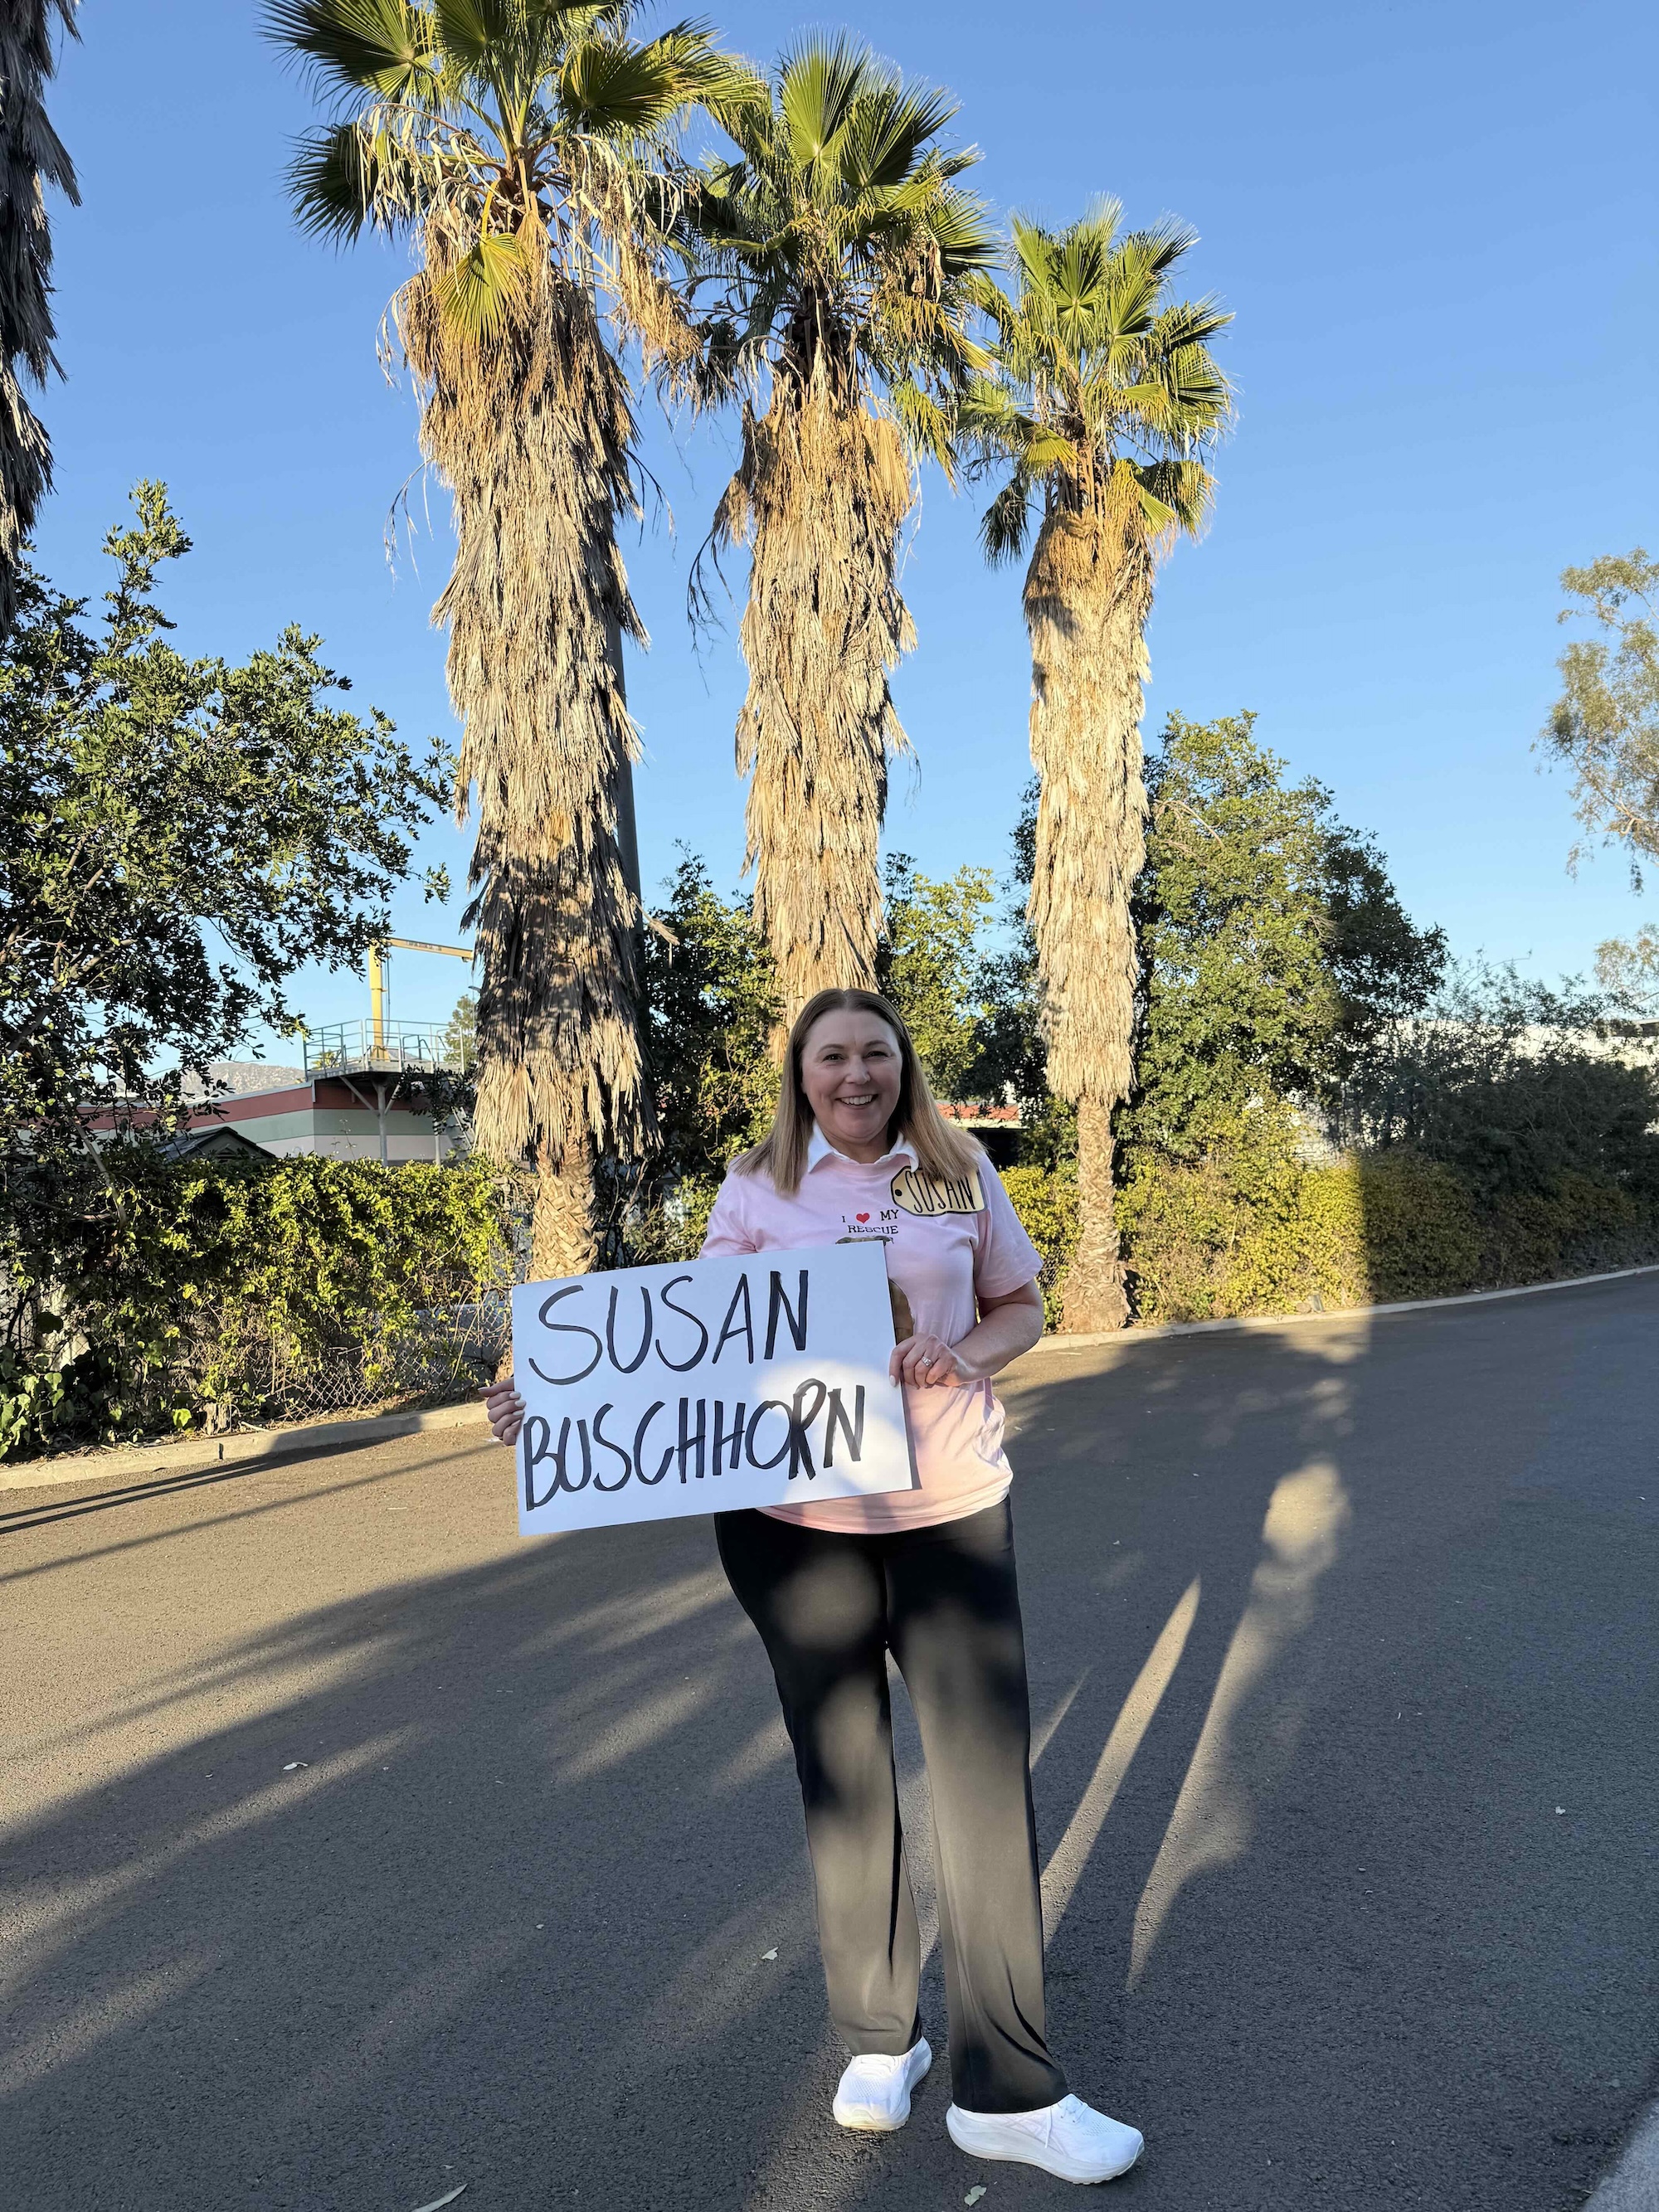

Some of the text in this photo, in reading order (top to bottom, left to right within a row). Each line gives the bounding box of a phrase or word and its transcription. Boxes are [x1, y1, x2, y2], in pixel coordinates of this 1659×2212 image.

[905, 1170, 976, 1213] SUSAN
[841, 1209, 899, 1223] I MY
[848, 1225, 899, 1234] RESCUE
[528, 1270, 809, 1385] SUSAN
[523, 1378, 865, 1511] BUSCHHORN
